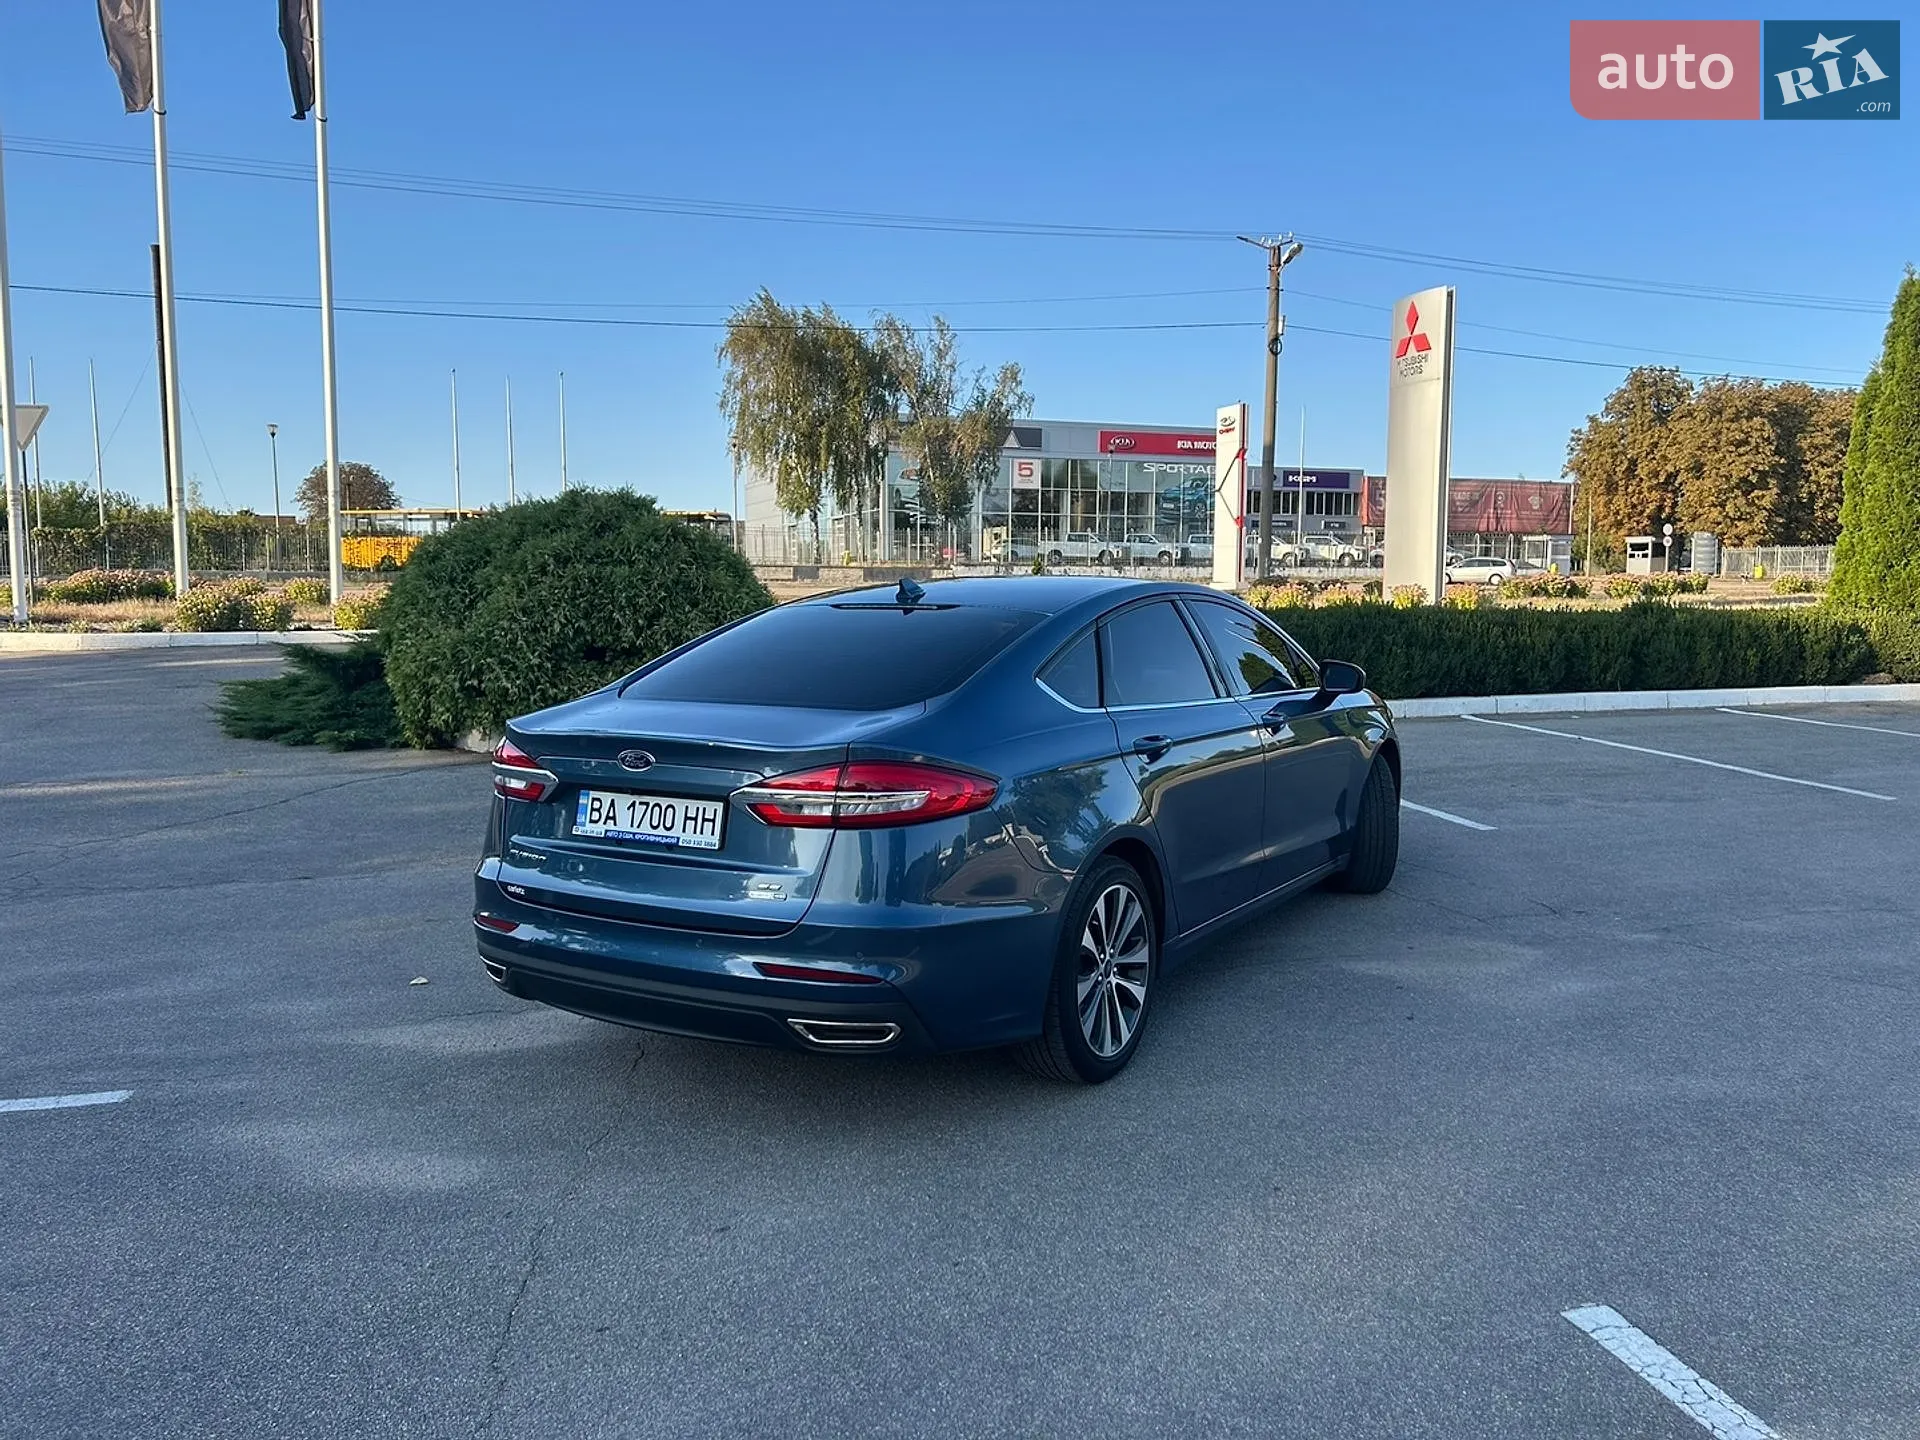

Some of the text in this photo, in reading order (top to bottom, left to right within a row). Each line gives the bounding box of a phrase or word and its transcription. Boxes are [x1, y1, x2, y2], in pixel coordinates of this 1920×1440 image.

[1397, 353, 1429, 366] MITSUBISHI
[1400, 364, 1424, 378] MOTORS
[1114, 438, 1131, 447] KIA
[1177, 440, 1193, 449] KIA
[1018, 462, 1033, 477] 5
[589, 797, 718, 836] BA 1700 HH
